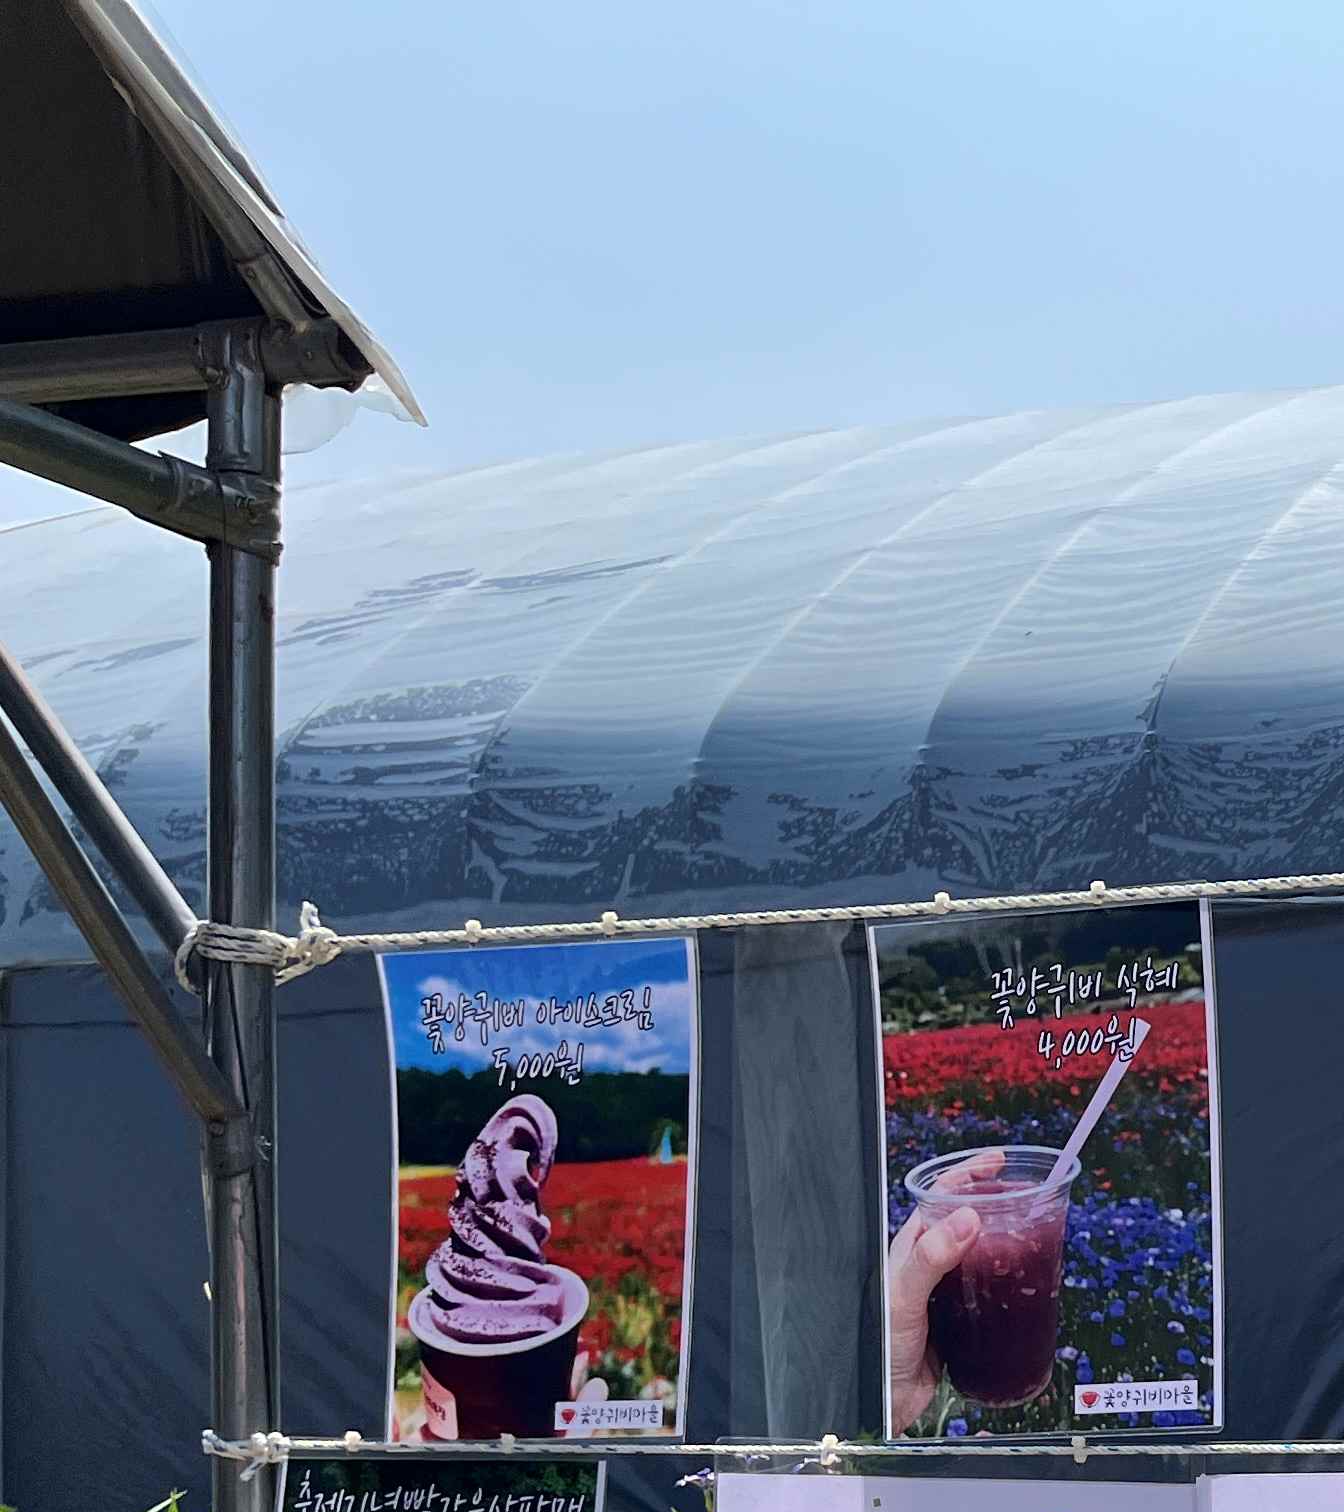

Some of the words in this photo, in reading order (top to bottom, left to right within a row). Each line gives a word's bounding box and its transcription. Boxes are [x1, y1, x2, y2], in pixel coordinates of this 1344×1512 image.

[420, 991, 526, 1053] 꽃양귀비
[536, 986, 655, 1031] 아이스크림
[990, 963, 1103, 1030] 꽃양귀비
[1116, 957, 1181, 1008] 식혜
[493, 1042, 585, 1091] 5,000원
[1038, 1015, 1140, 1070] 4,000원
[580, 1403, 660, 1426] 꽃양귀비마을
[1103, 1385, 1194, 1409] 꽃양귀비마을
